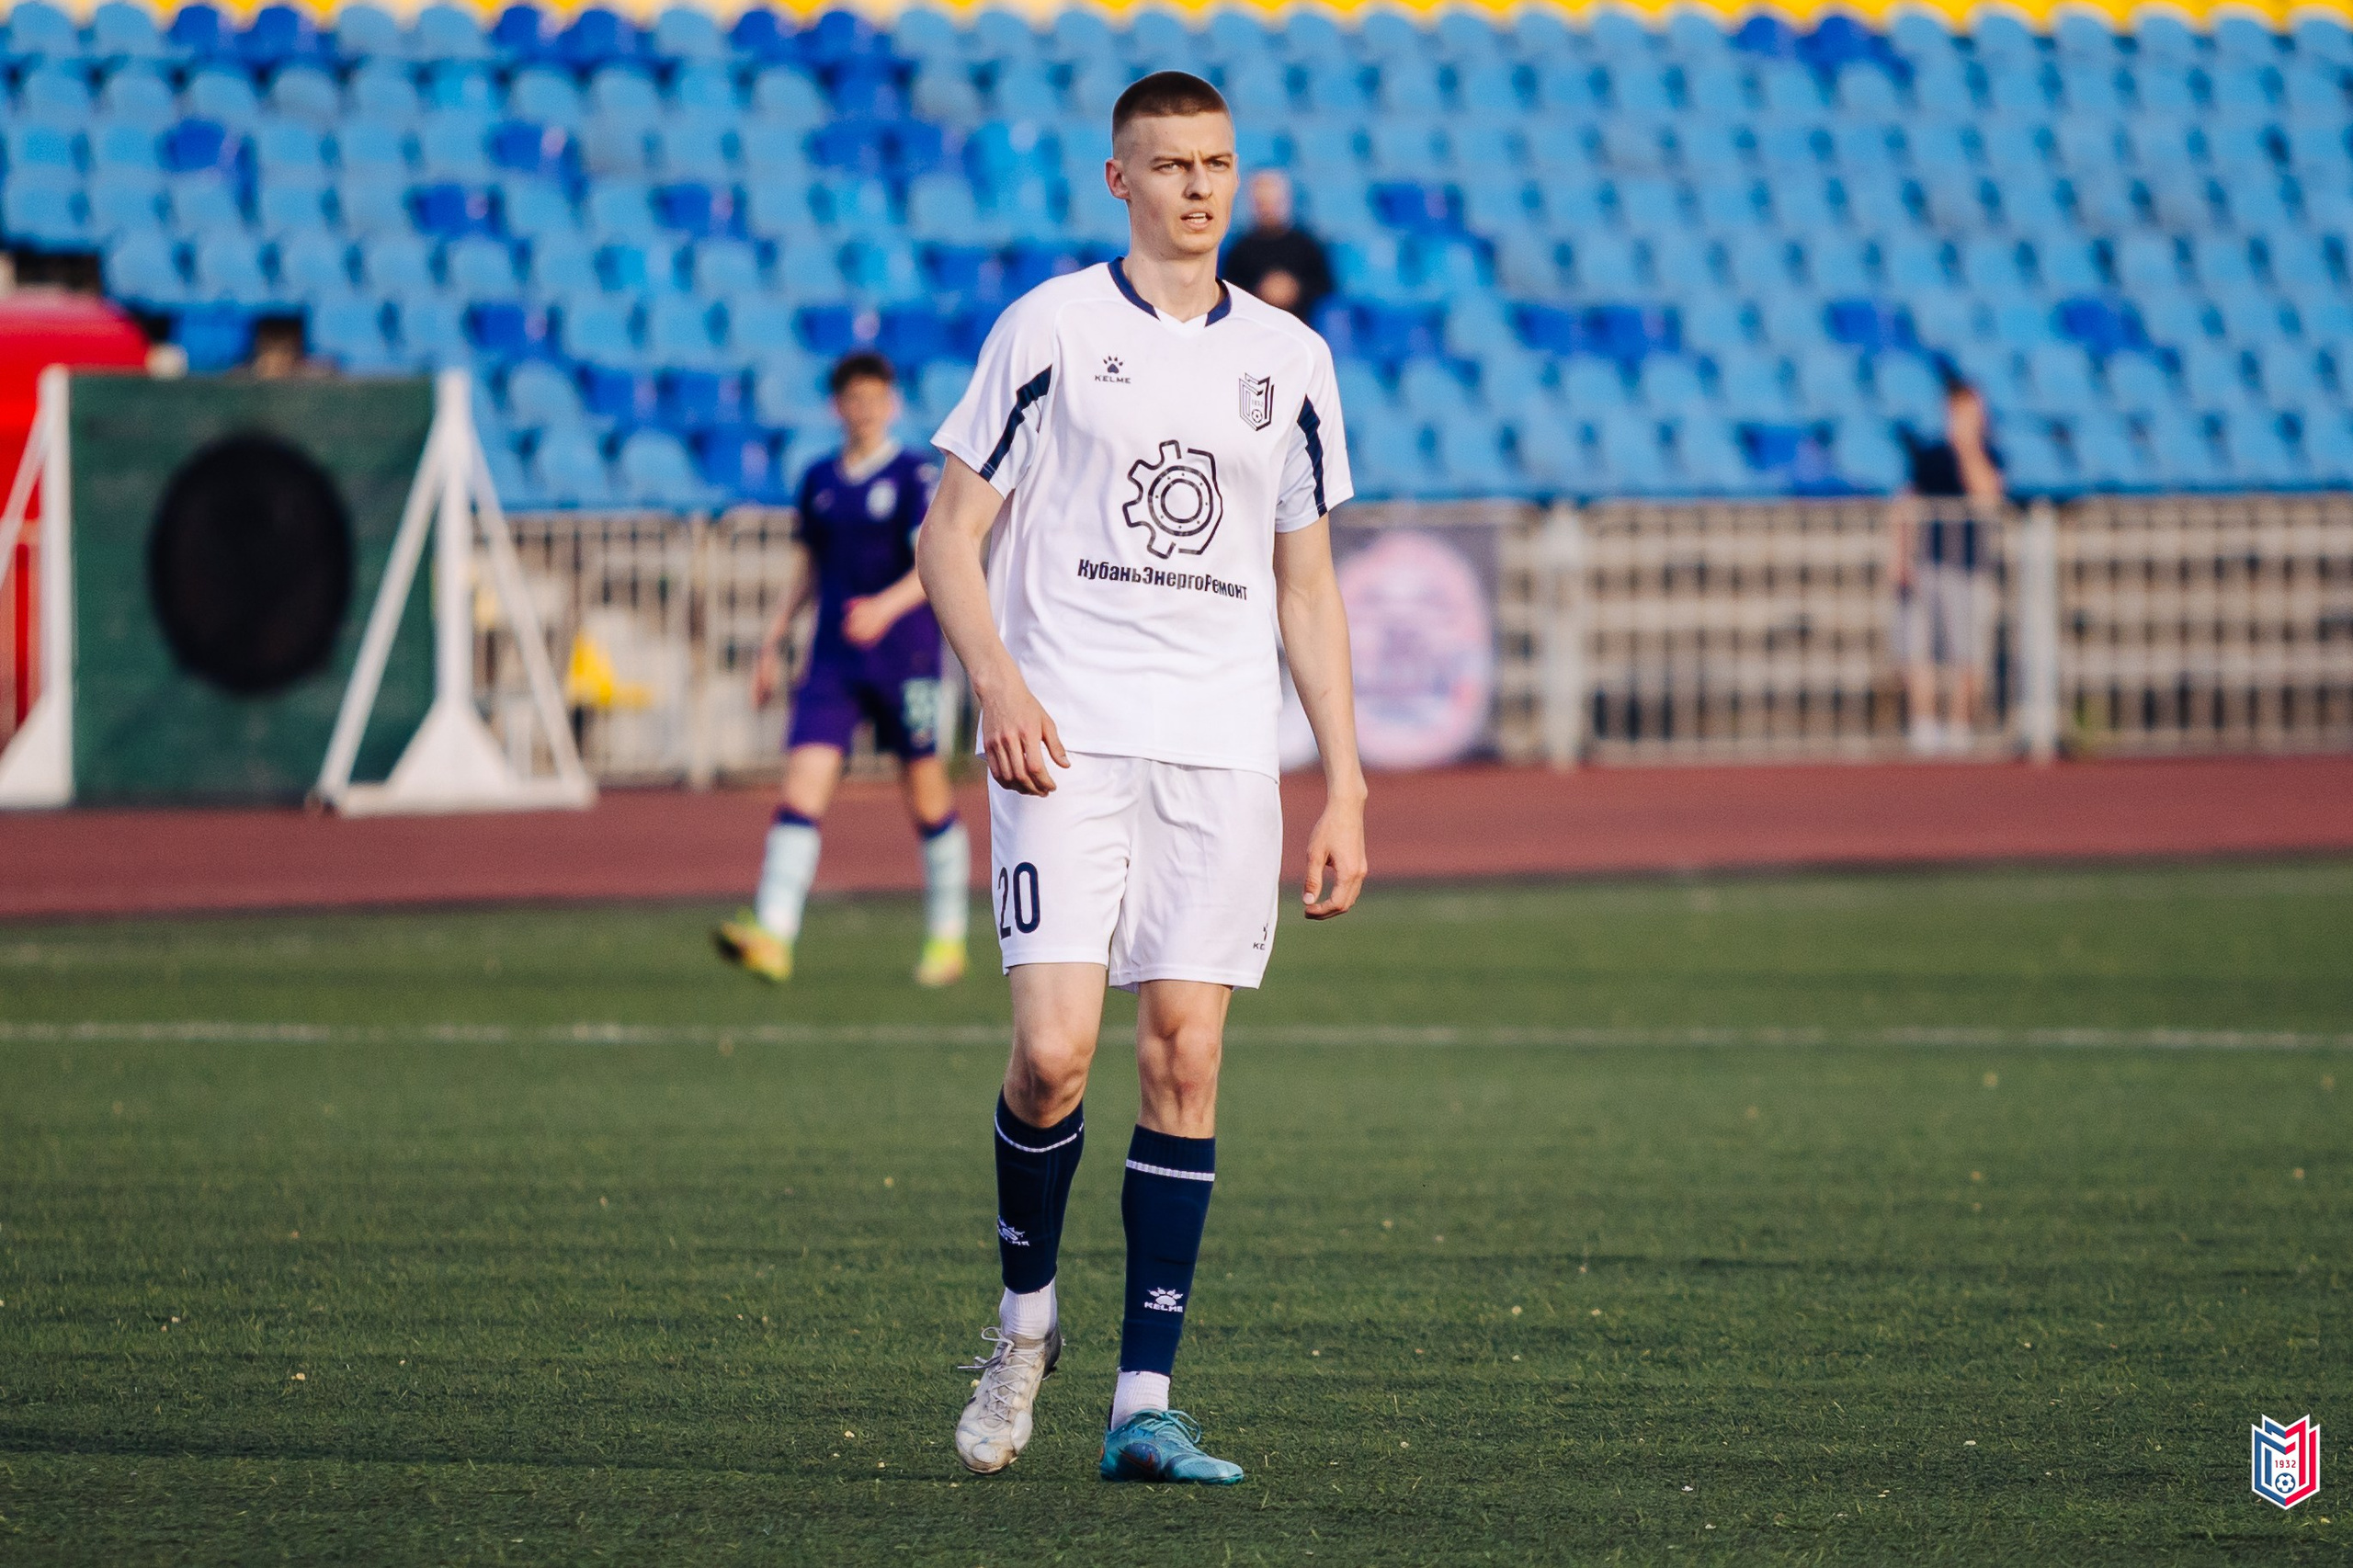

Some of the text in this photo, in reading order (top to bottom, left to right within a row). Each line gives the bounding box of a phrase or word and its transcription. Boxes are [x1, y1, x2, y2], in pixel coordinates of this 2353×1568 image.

[1094, 374, 1131, 384] KELME
[1077, 559, 1247, 600] КубаньЭнергоРемонт
[997, 861, 1040, 940] 20
[1143, 1301, 1183, 1312] KELME
